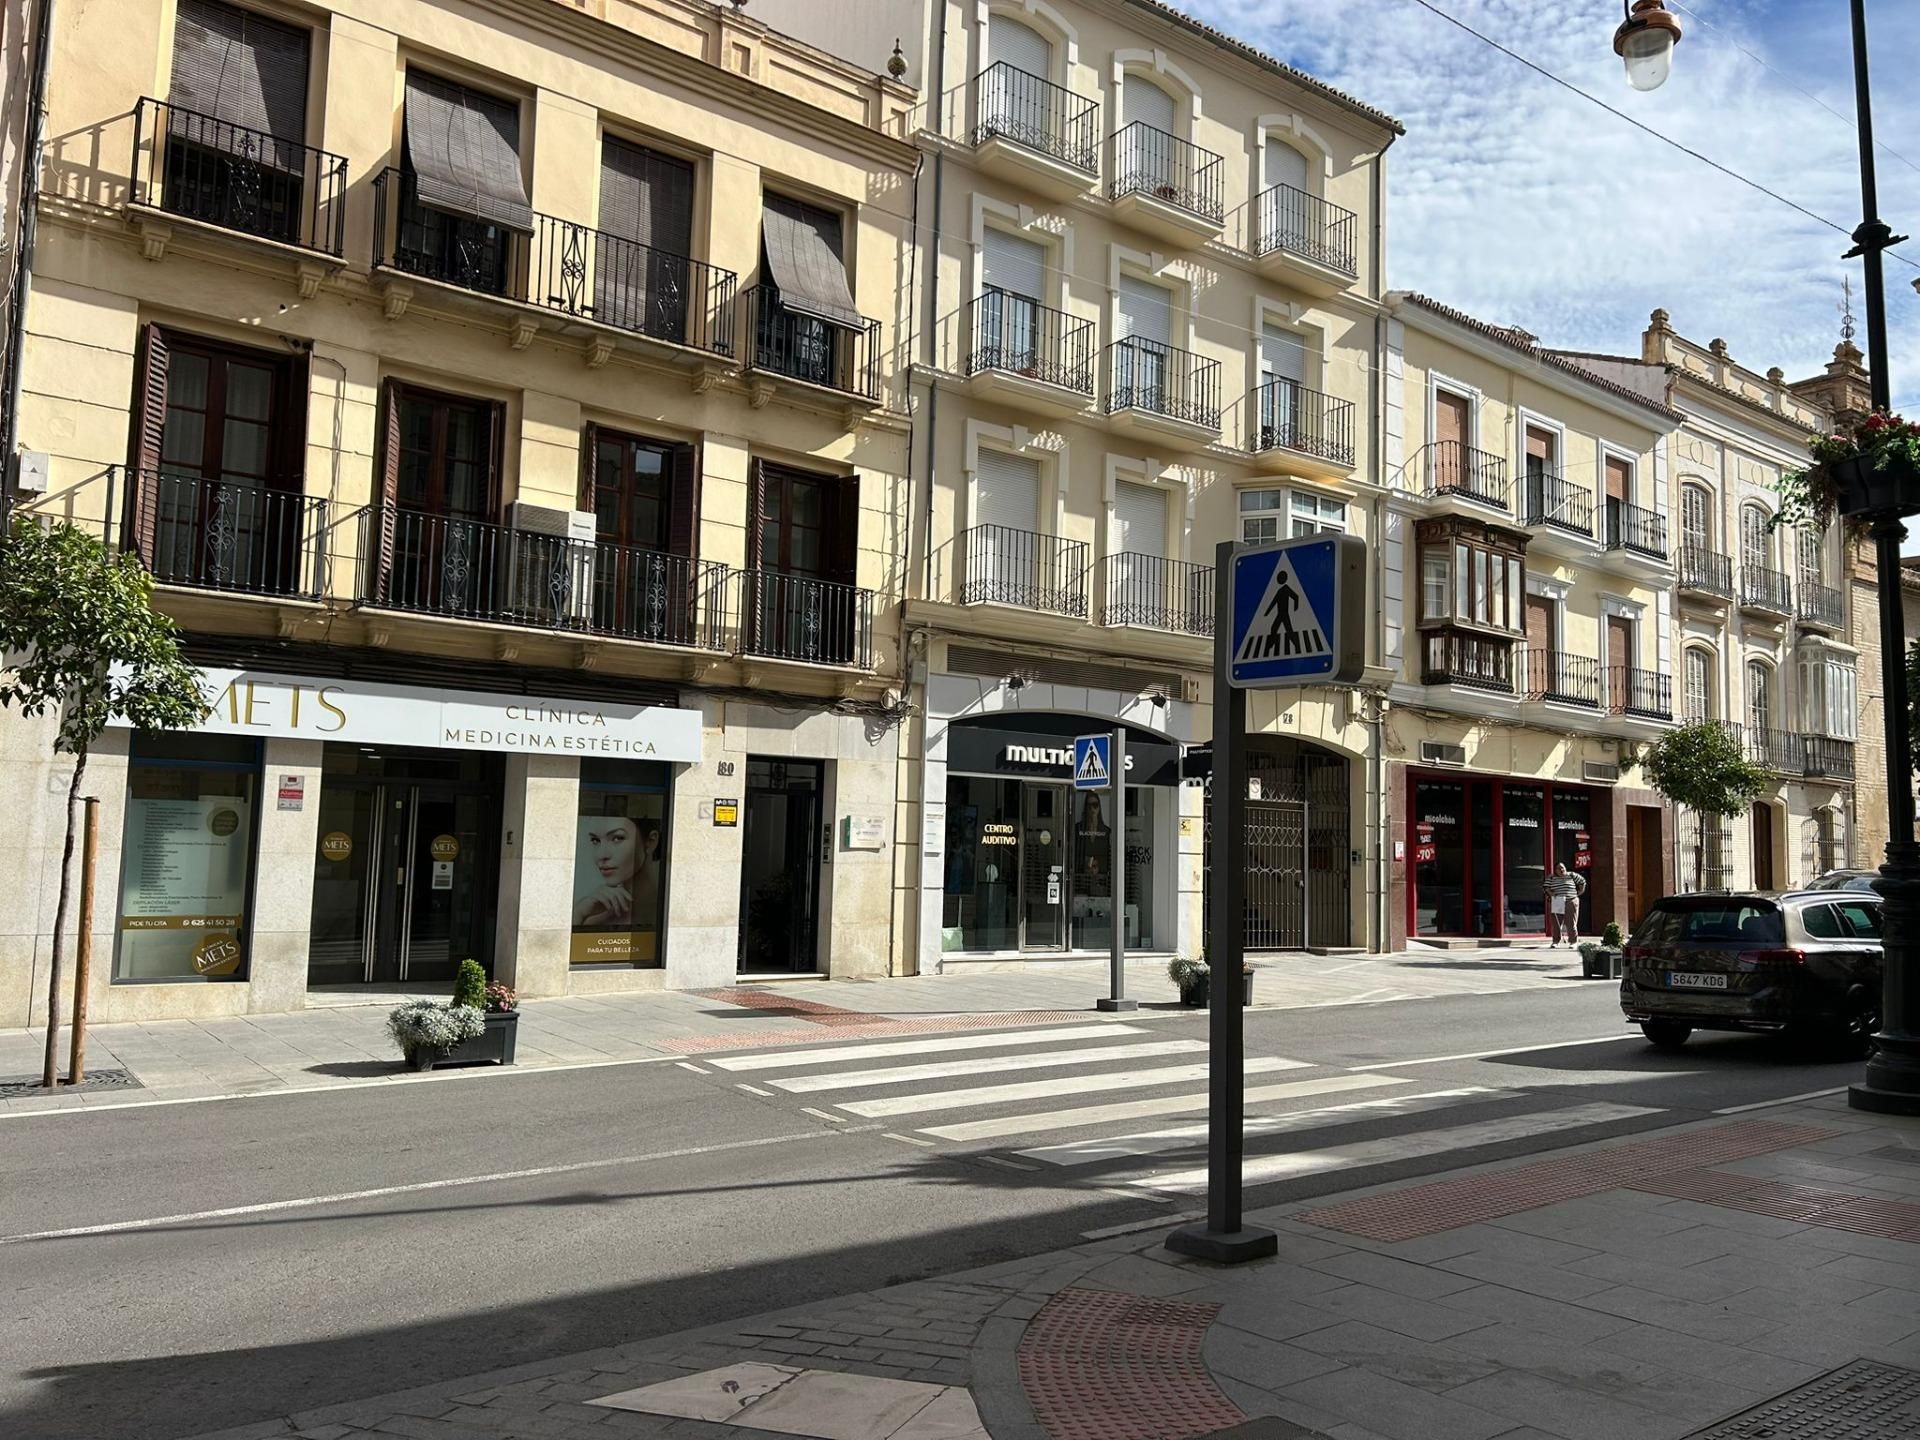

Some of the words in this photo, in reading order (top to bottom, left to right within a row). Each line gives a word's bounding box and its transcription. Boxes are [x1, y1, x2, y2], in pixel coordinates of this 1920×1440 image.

[505, 702, 607, 727] CLÍNICA
[445, 728, 557, 749] MEDICINA
[563, 735, 657, 755] ESTÉTICA
[984, 823, 1014, 834] CENTRO
[323, 840, 350, 850] METS
[981, 835, 1017, 846] AUDITIVO
[432, 843, 457, 851] METS
[196, 941, 236, 968] METS
[1673, 974, 1700, 985] 5647
[1702, 975, 1724, 987] KDG
